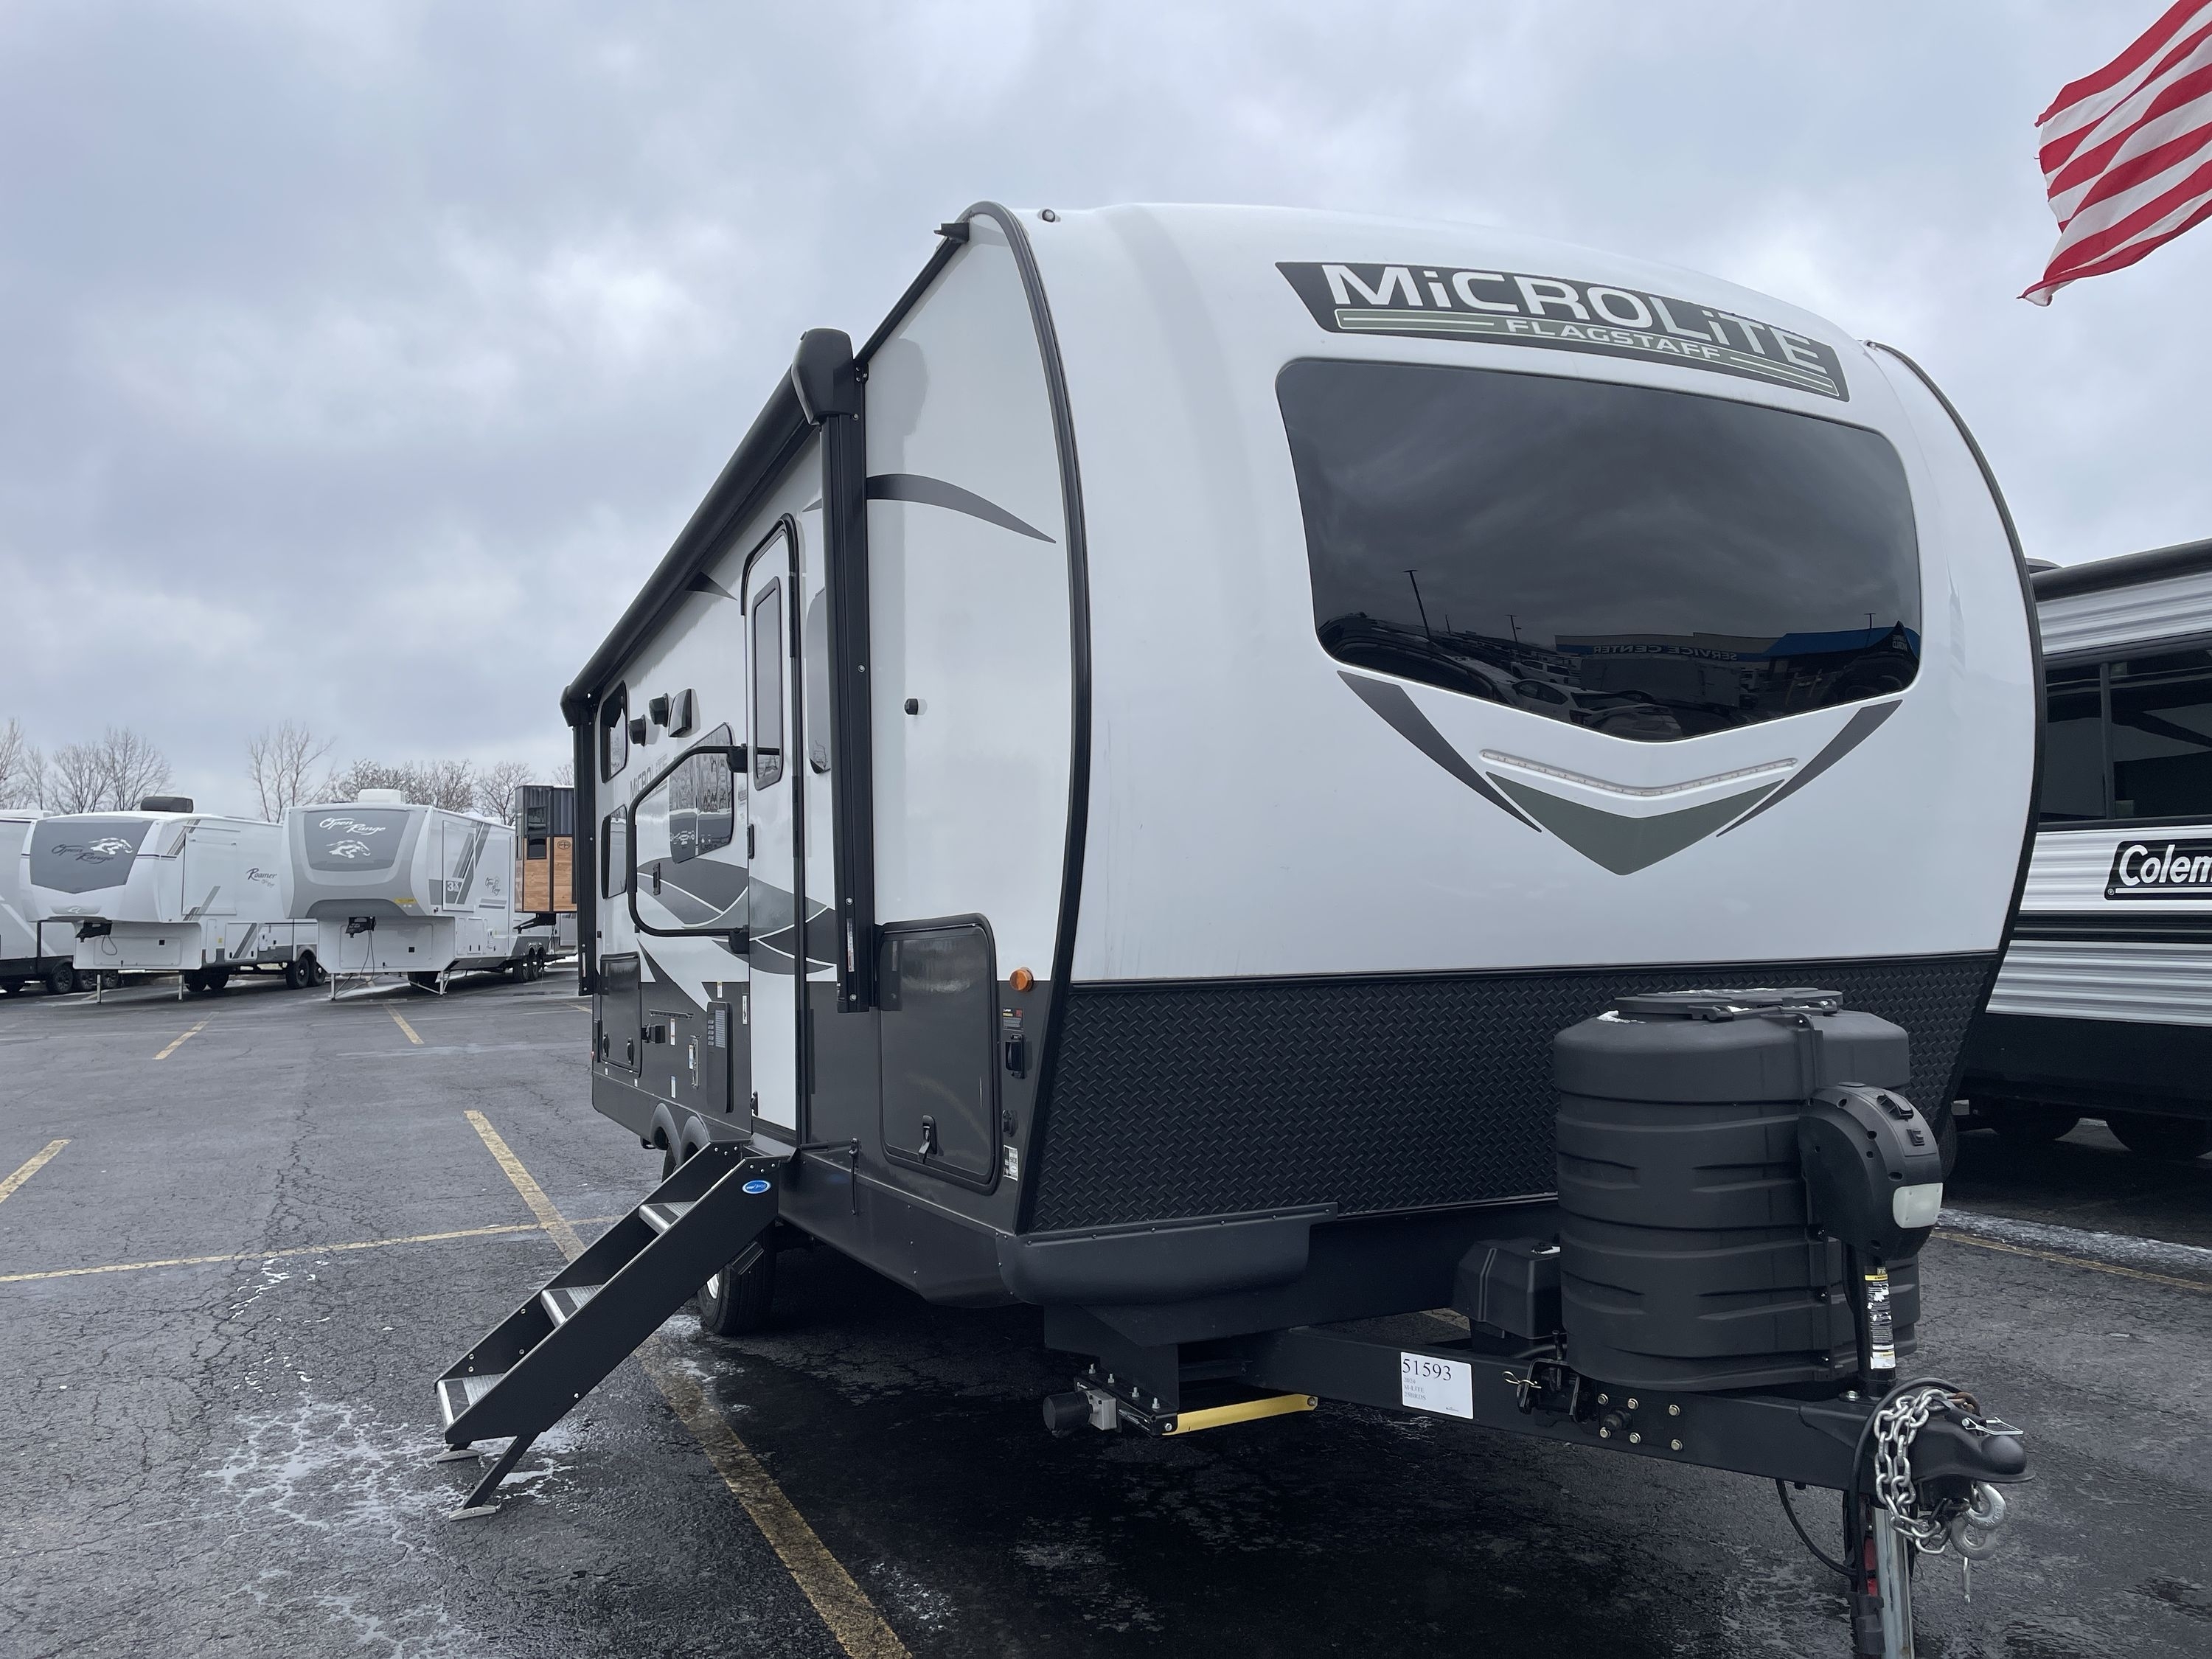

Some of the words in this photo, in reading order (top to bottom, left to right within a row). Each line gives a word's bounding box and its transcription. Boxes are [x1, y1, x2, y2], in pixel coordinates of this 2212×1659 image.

[1505, 319, 1722, 360] FLAGSTAFF
[319, 817, 355, 830] Open
[343, 824, 386, 835] Range
[52, 844, 84, 856] Open
[75, 852, 114, 864] Range
[1402, 1358, 1452, 1381] 51593
[1404, 1385, 1425, 1393] M-LITE
